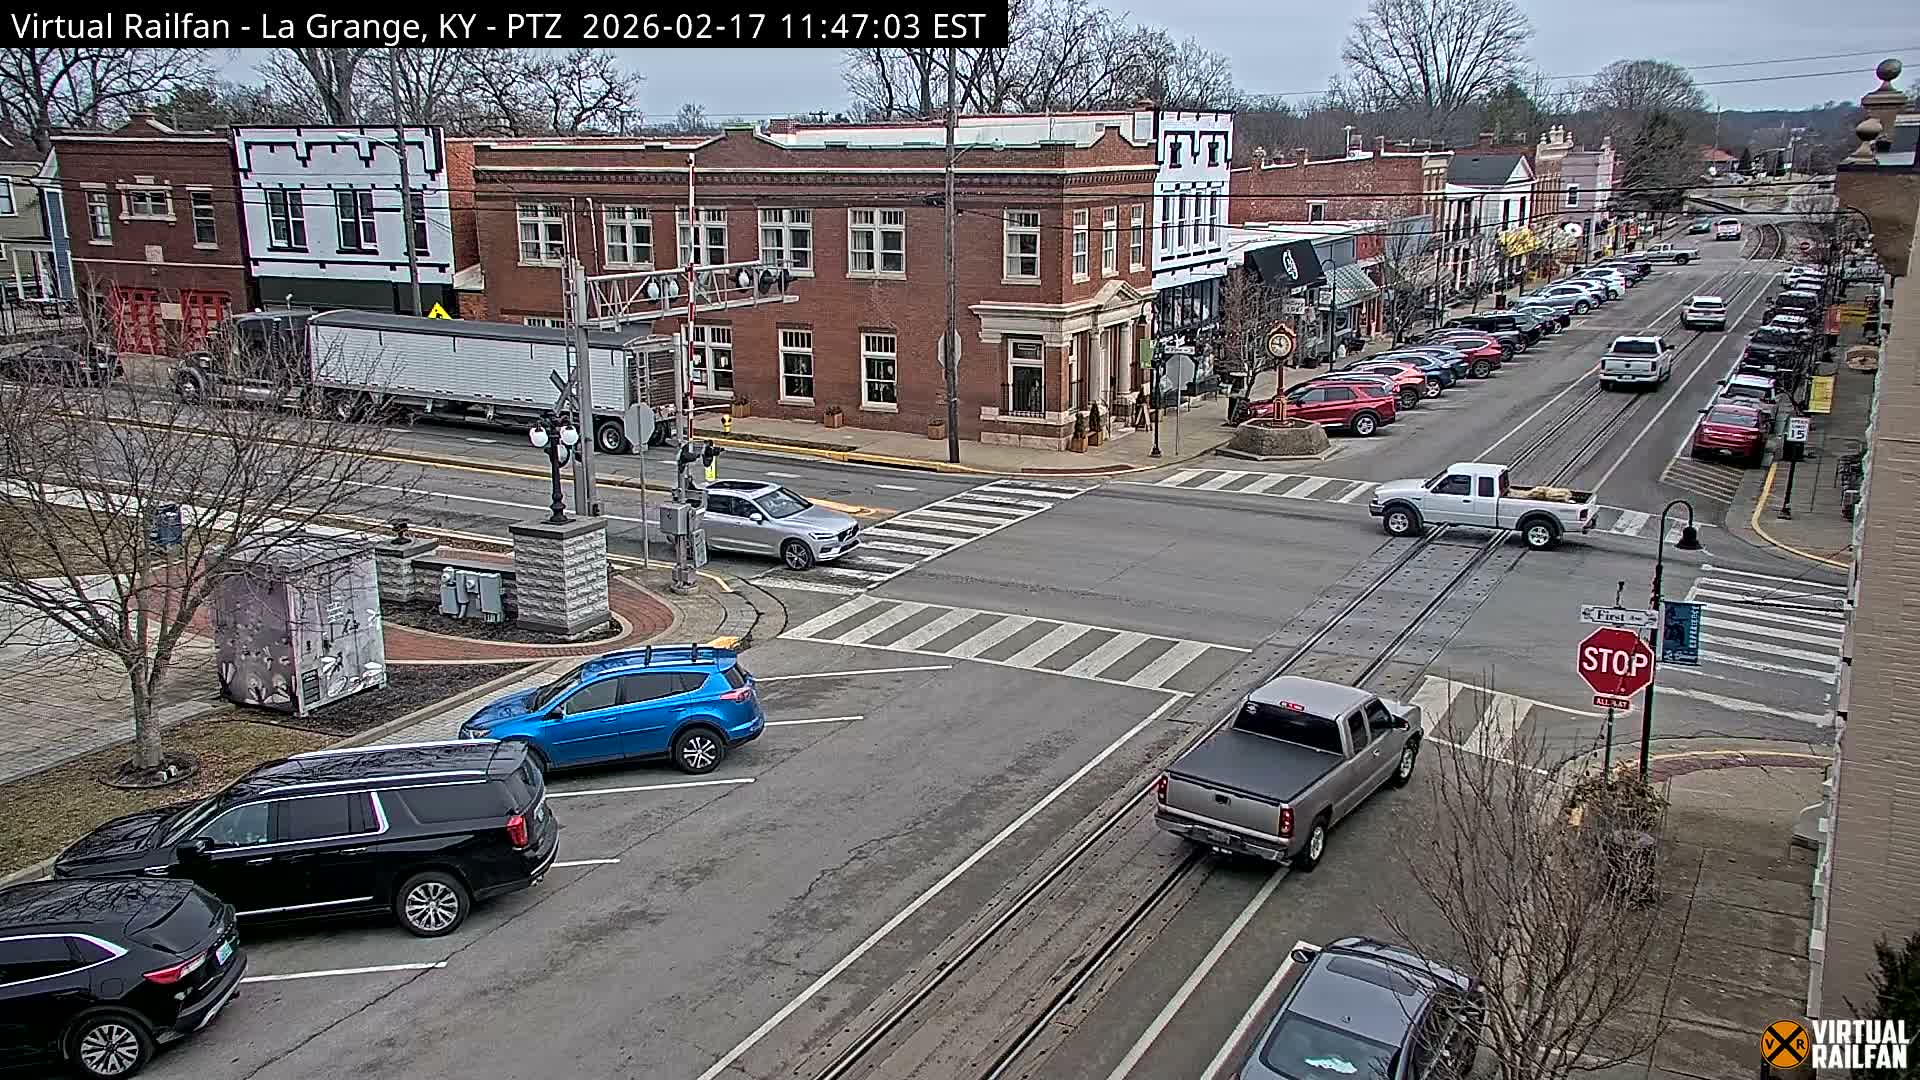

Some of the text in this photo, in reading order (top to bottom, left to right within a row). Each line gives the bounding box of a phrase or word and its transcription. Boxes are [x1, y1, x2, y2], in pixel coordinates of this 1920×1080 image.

[1791, 430, 1805, 439] 15
[1597, 609, 1625, 622] First
[1582, 646, 1648, 676] STOP
